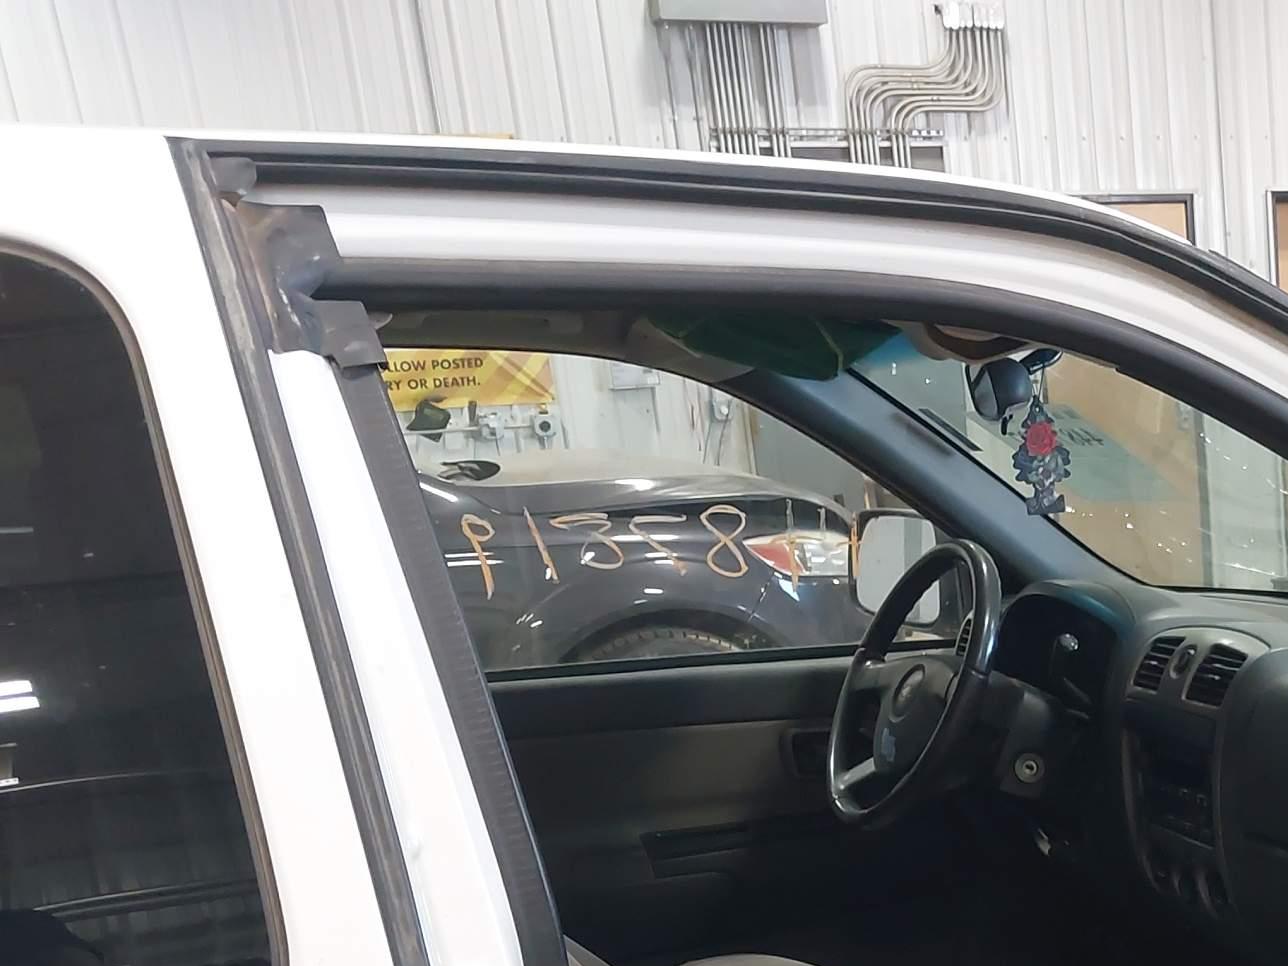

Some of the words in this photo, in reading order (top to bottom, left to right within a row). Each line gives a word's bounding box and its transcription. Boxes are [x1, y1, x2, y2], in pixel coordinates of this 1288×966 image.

[431, 357, 484, 370] POSTED
[407, 378, 428, 389] OR
[433, 376, 481, 388] DEATH.
